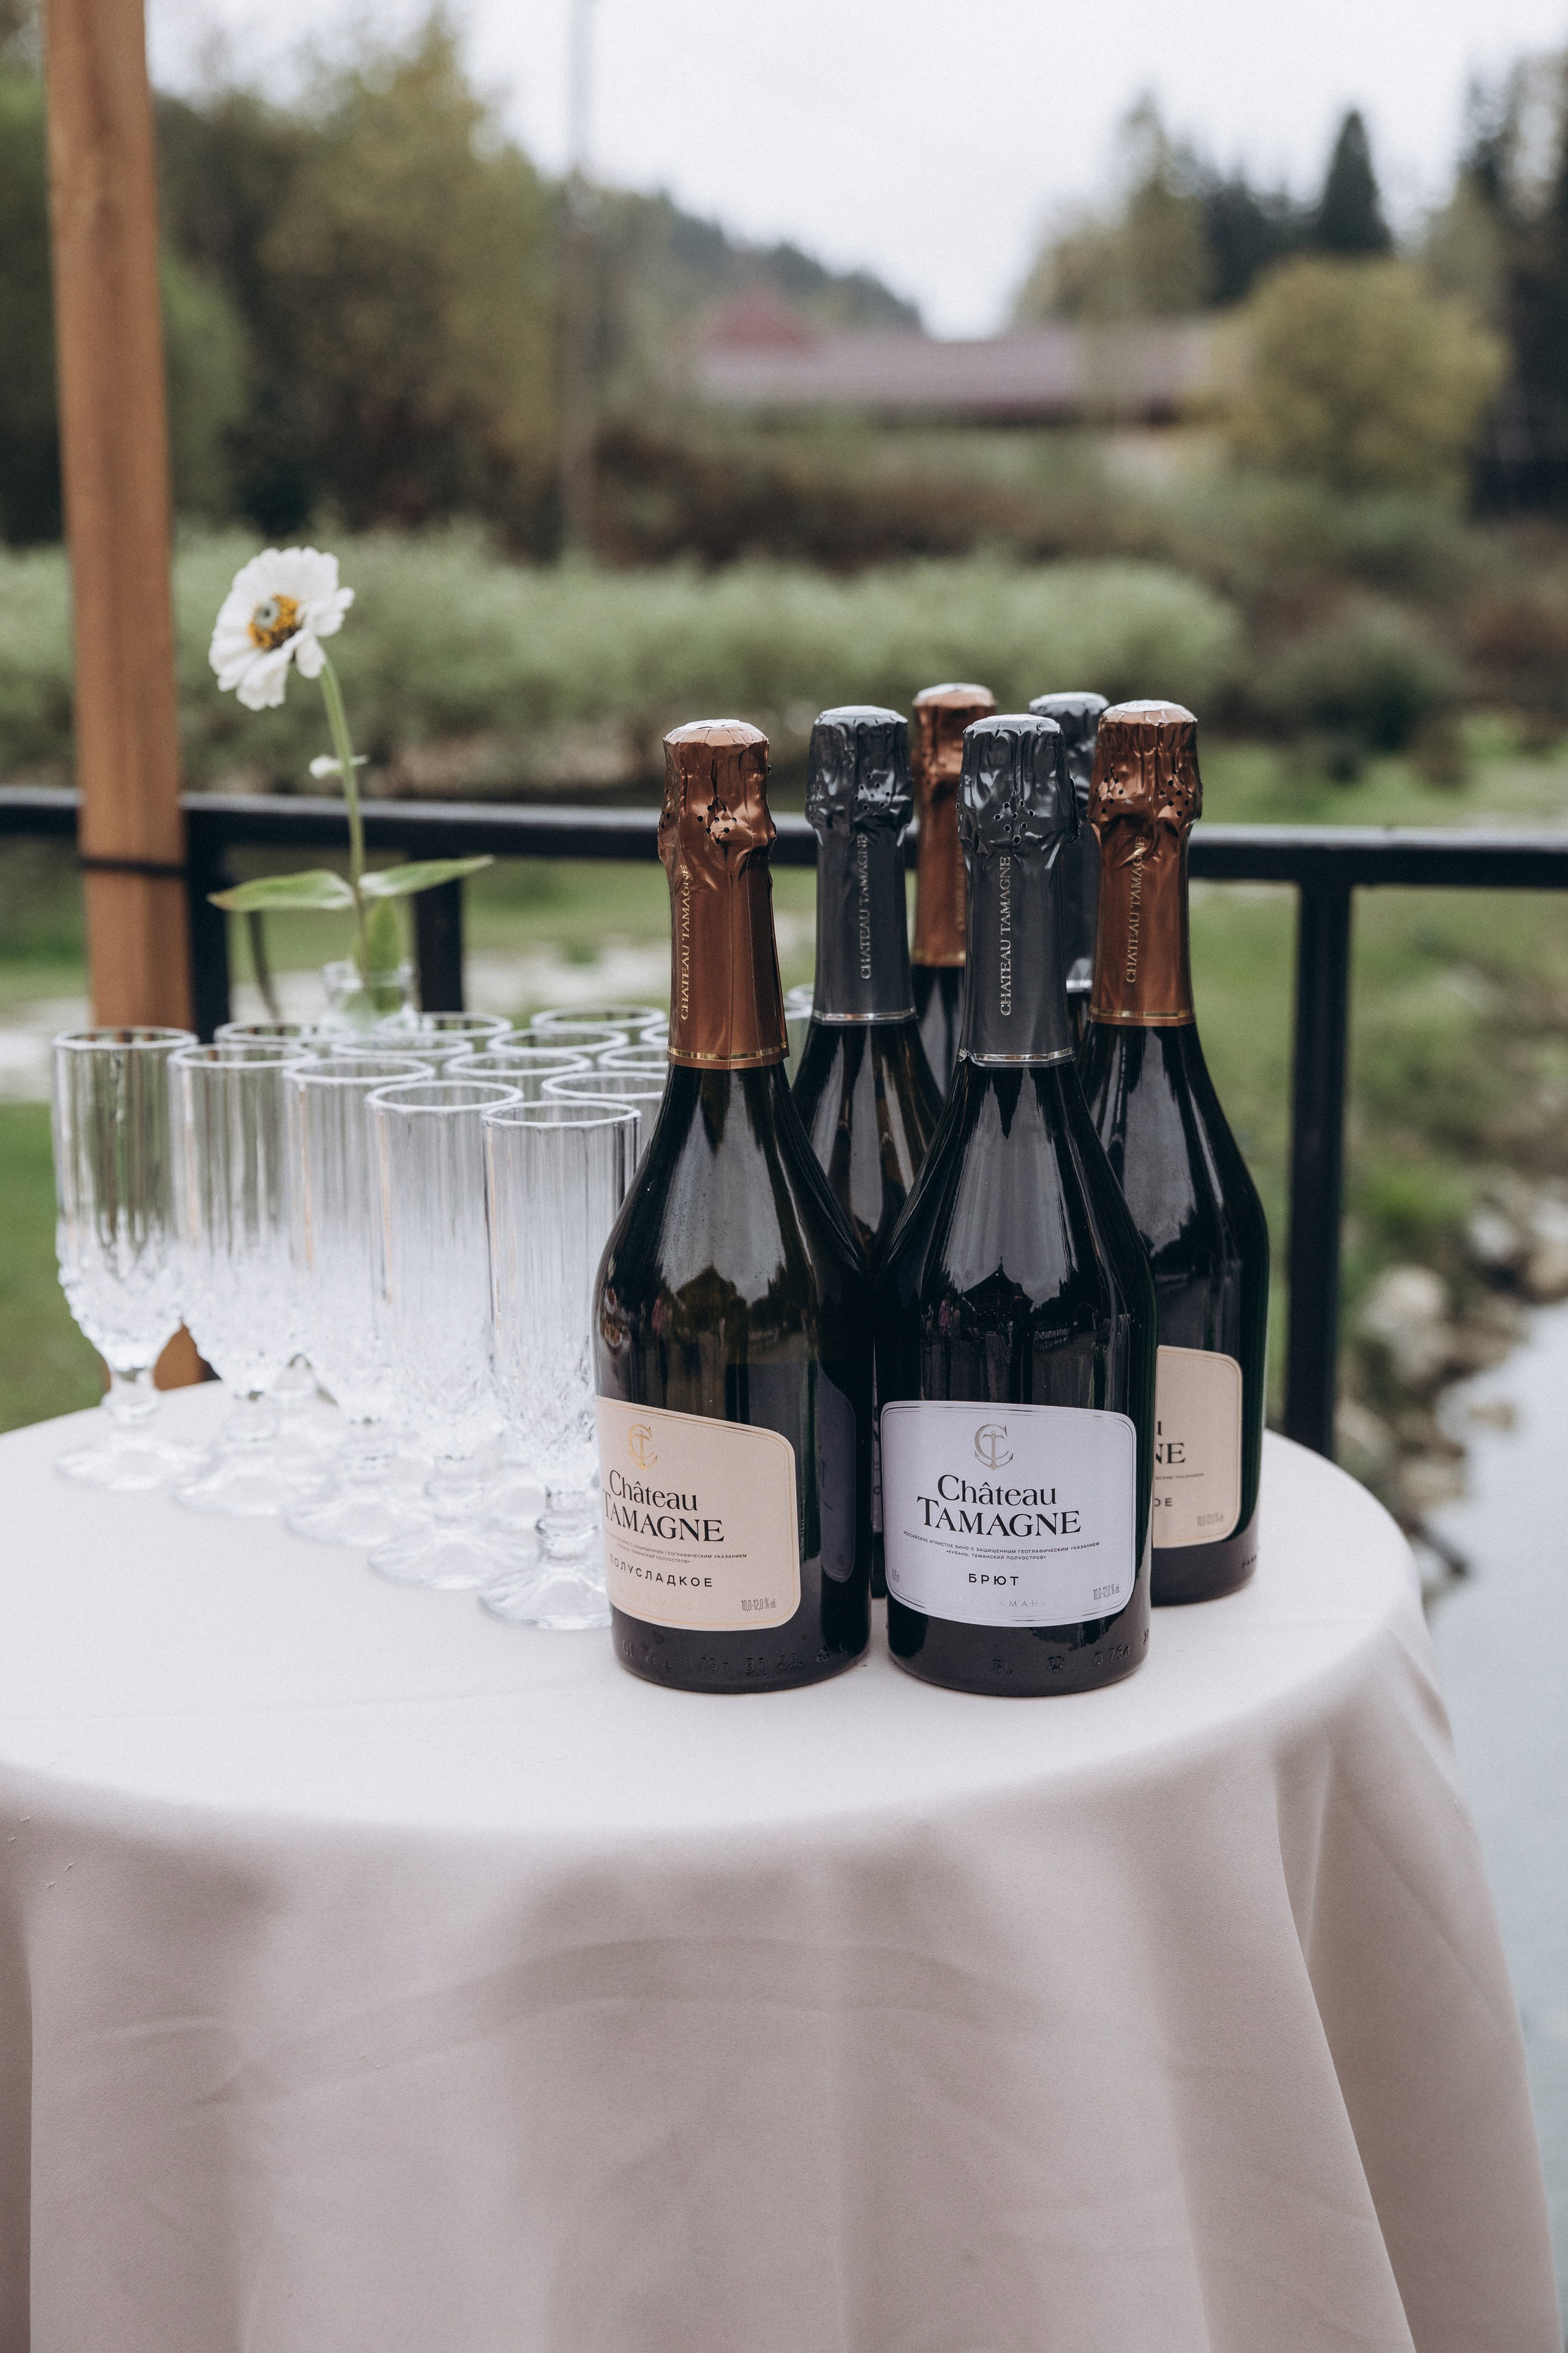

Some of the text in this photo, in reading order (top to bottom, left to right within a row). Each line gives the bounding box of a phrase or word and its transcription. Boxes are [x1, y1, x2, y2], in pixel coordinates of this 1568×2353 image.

[857, 833, 871, 980] CHATEAU TAMAGNE
[1126, 836, 1145, 983] CHATEAU TAMAGNE
[680, 864, 690, 1020] CHATEAU TAMAGNE
[1000, 856, 1011, 1016] CHATEAU TAMAGNE
[609, 1470, 698, 1511] Château
[937, 1474, 1057, 1506] Château
[602, 1488, 725, 1542] TAMAGNE
[917, 1496, 1082, 1537] TAMAGNE
[903, 1531, 928, 1543] РОССИЙСКОЕ
[929, 1539, 954, 1548] ИГРИСТОЕ
[609, 1554, 712, 1587] ПОЛУСЛАДКОЕ
[968, 1573, 1019, 1586] БРЮТ
[741, 1598, 764, 1612] 10,0-12,0
[764, 1598, 770, 1609] %
[1093, 1585, 1110, 1601] 10,0-12,0
